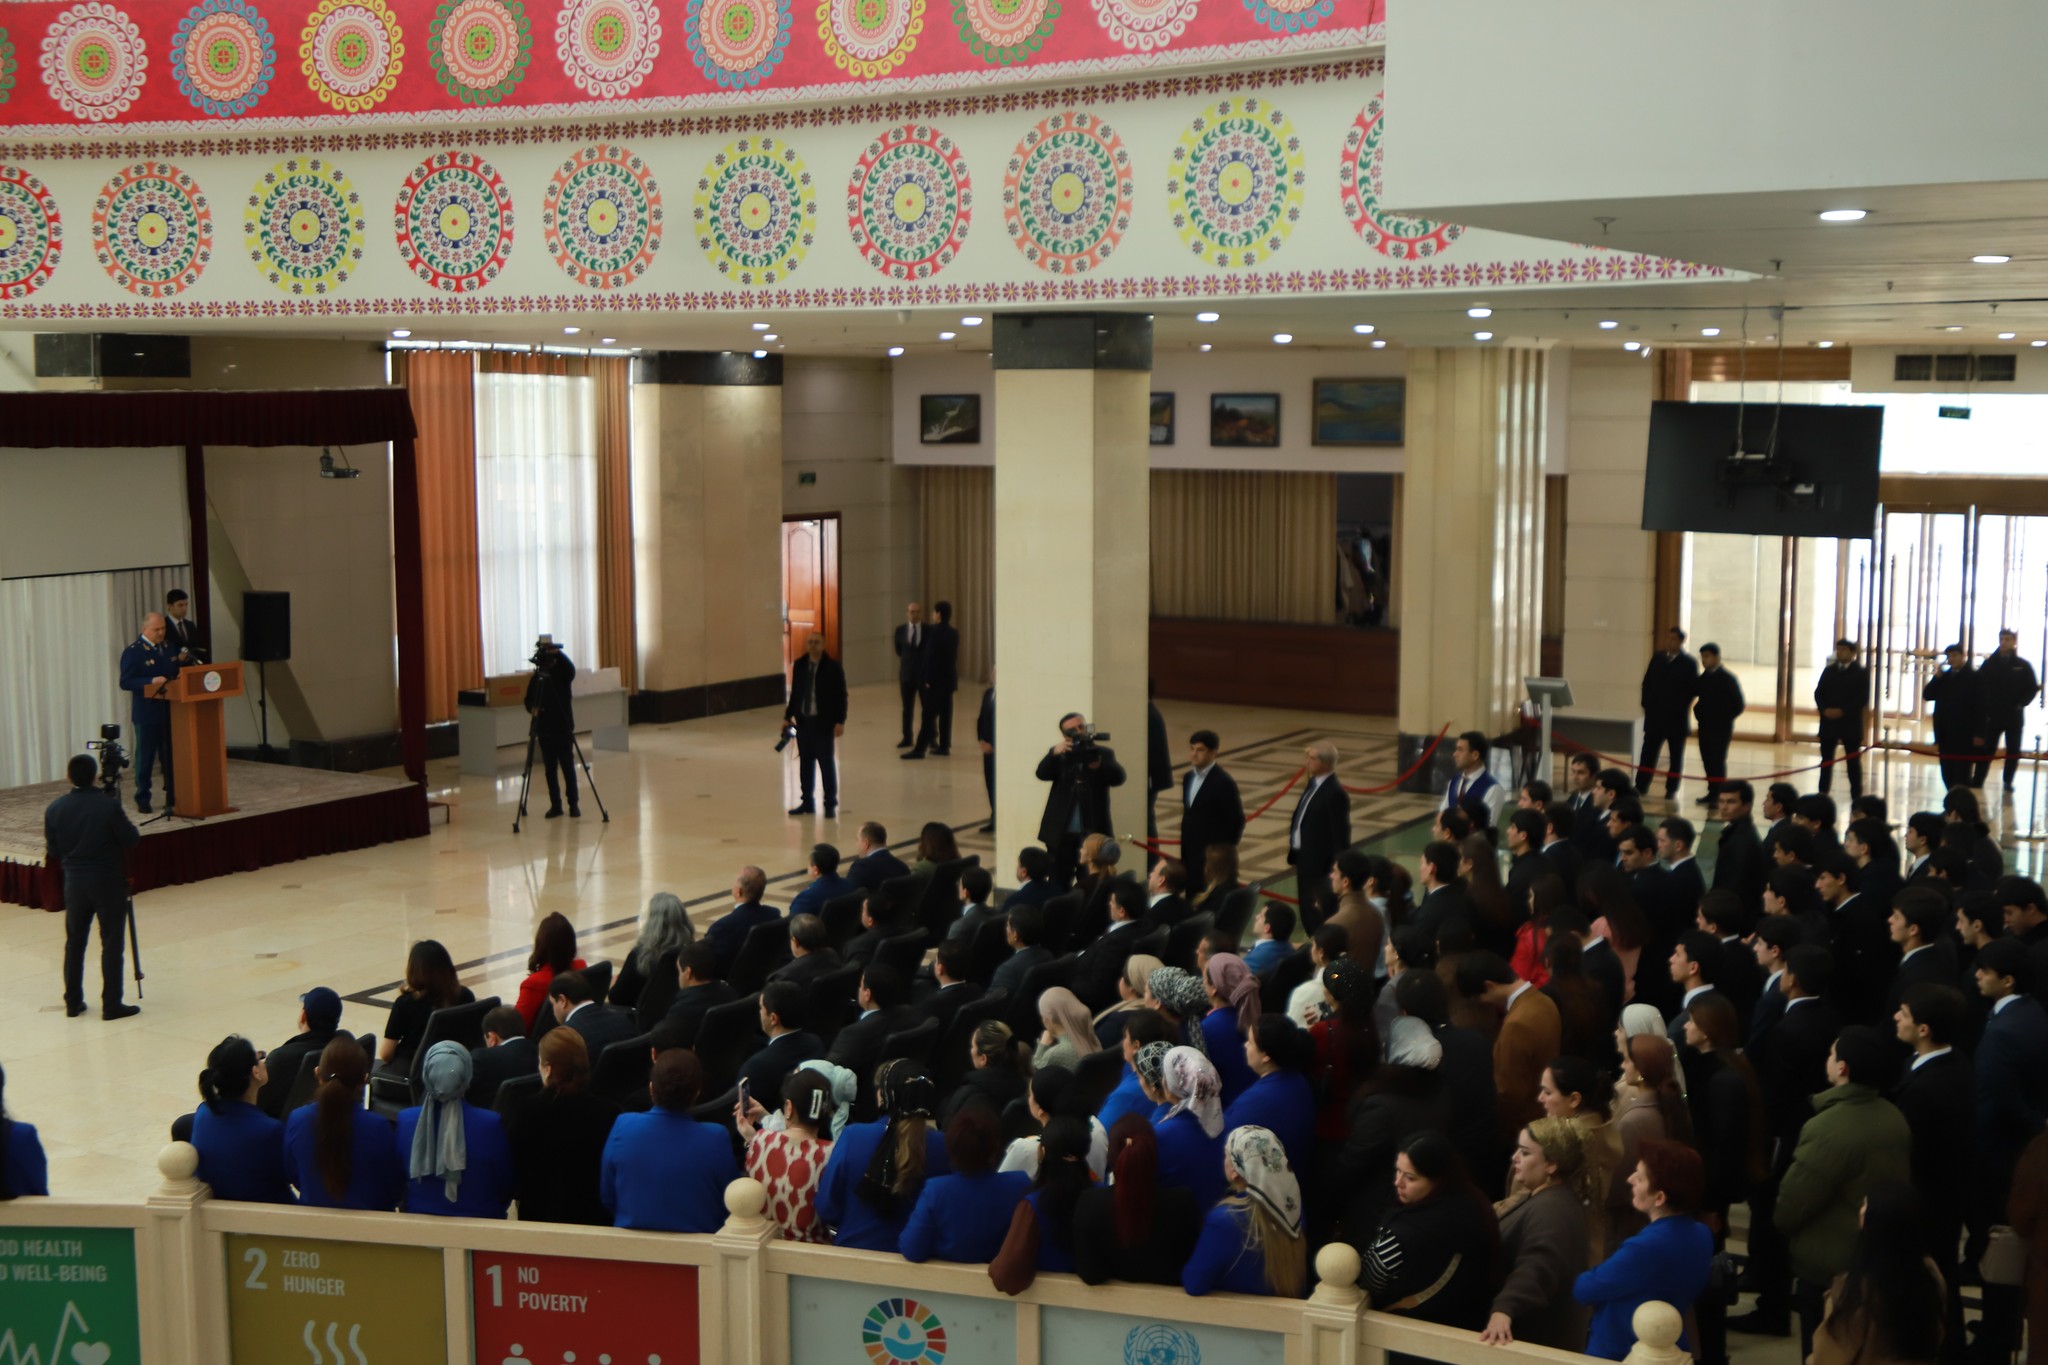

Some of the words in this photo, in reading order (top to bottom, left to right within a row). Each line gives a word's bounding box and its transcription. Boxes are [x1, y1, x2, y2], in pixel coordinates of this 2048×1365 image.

[23, 1239, 83, 1257] HEALTH
[243, 1247, 268, 1289] 2
[282, 1250, 320, 1269] ZERO
[12, 1264, 107, 1282] WELL-BEING
[517, 1266, 539, 1284] NO
[283, 1275, 345, 1296] HUNGER
[486, 1265, 503, 1307] 1
[518, 1291, 588, 1313] POVERTY
